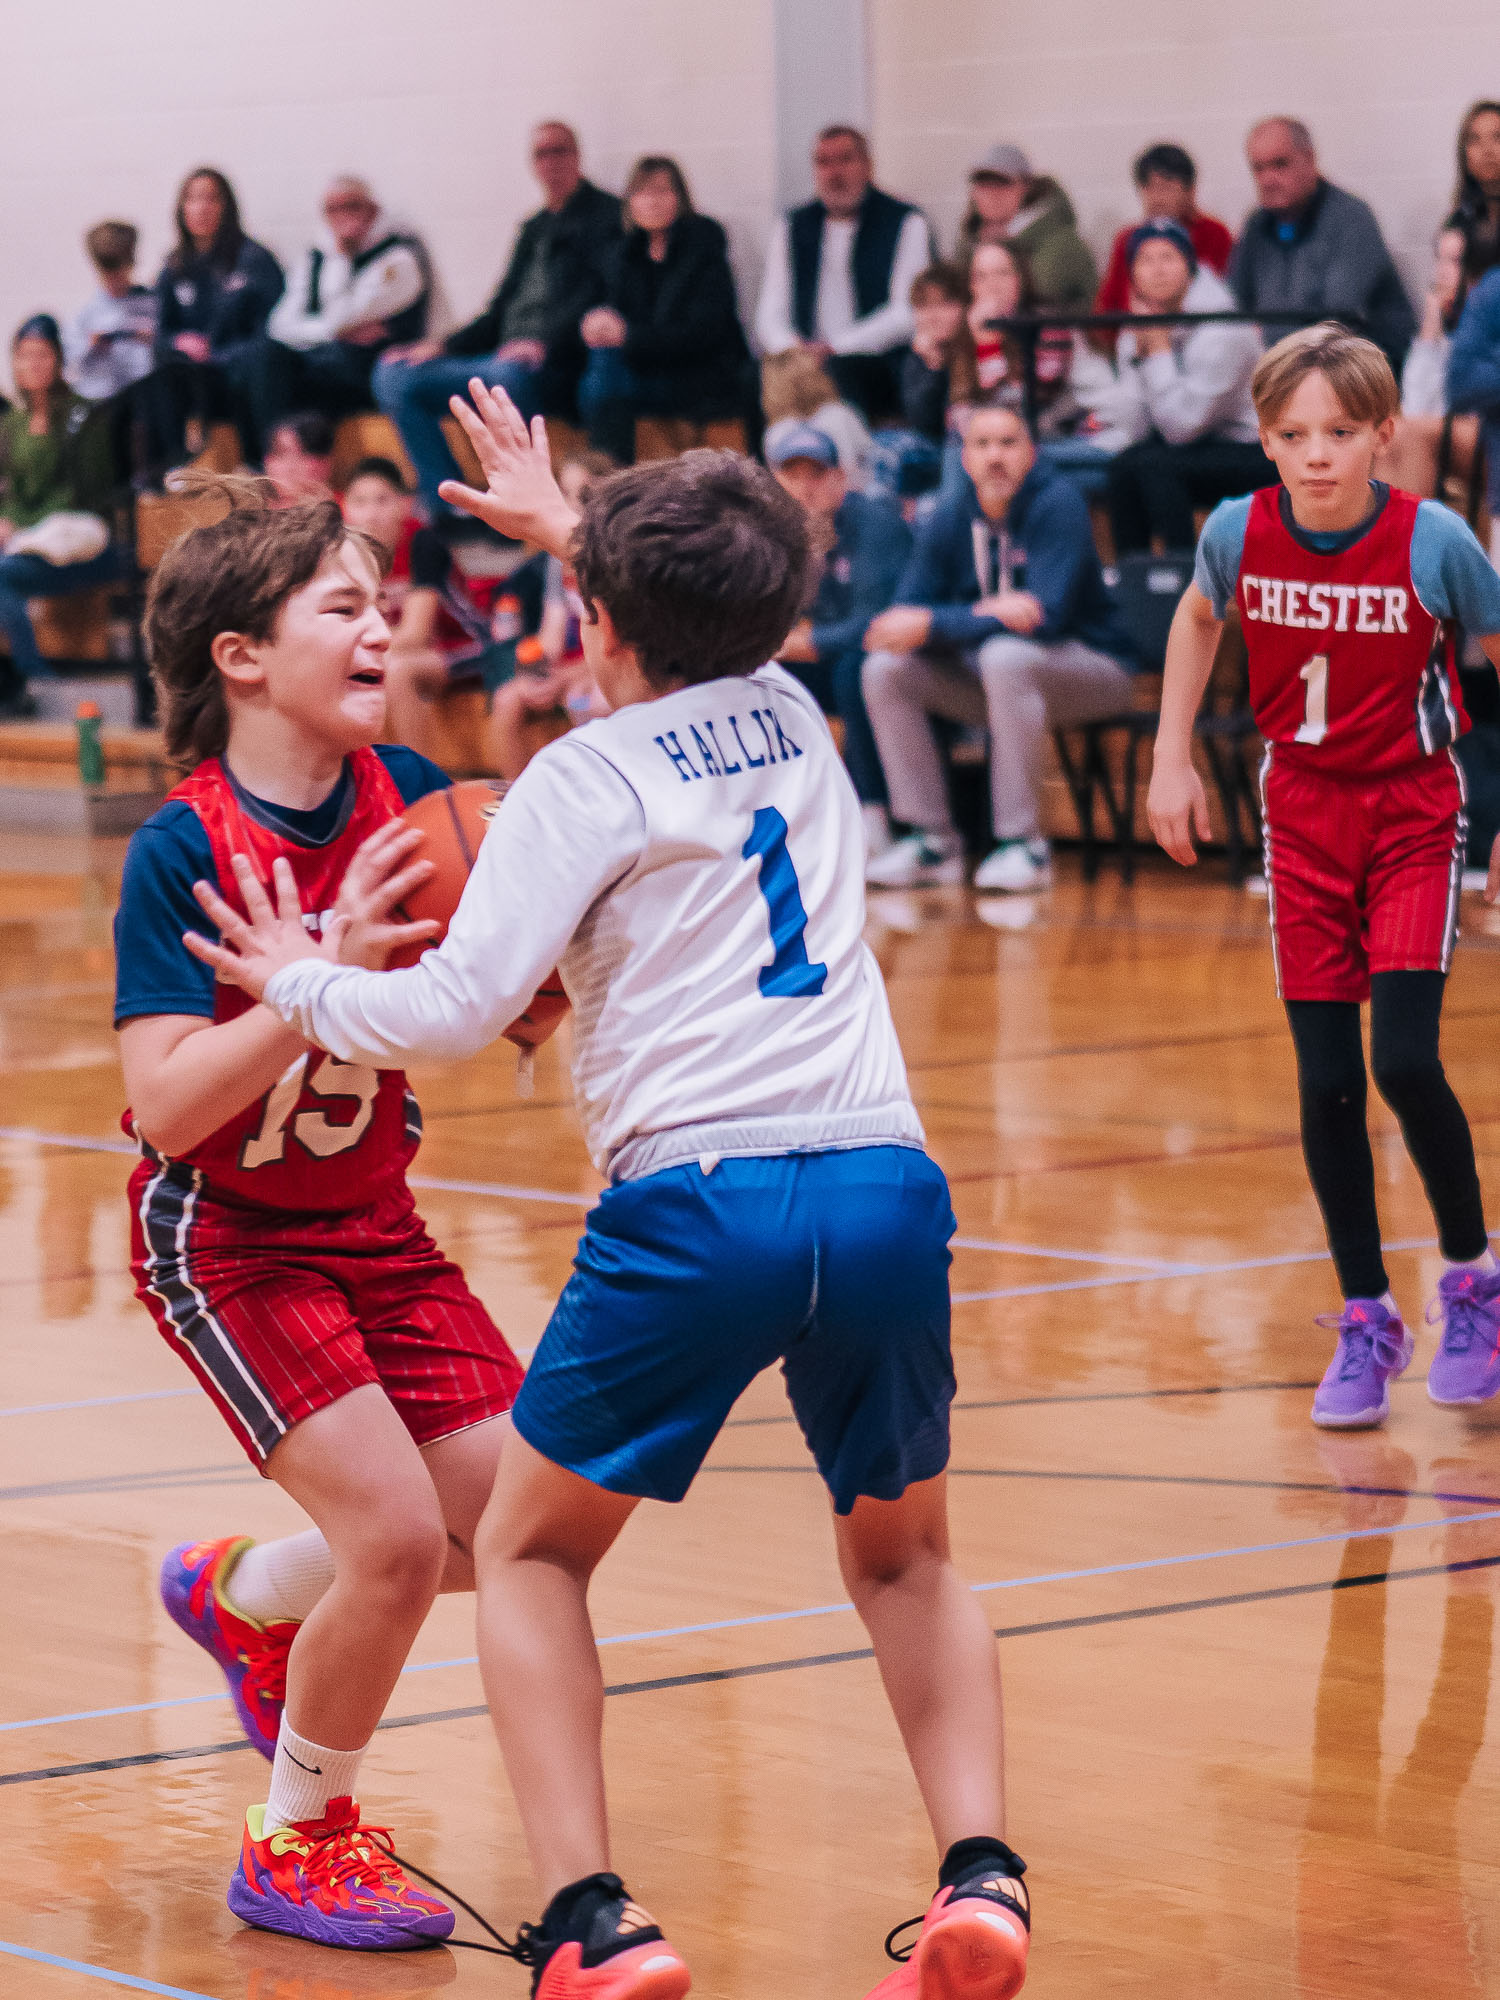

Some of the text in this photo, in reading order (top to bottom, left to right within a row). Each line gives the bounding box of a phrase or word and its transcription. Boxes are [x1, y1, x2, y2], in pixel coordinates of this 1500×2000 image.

[1241, 574, 1409, 634] CHESTER
[1294, 654, 1329, 745] 1
[742, 806, 828, 997] 1
